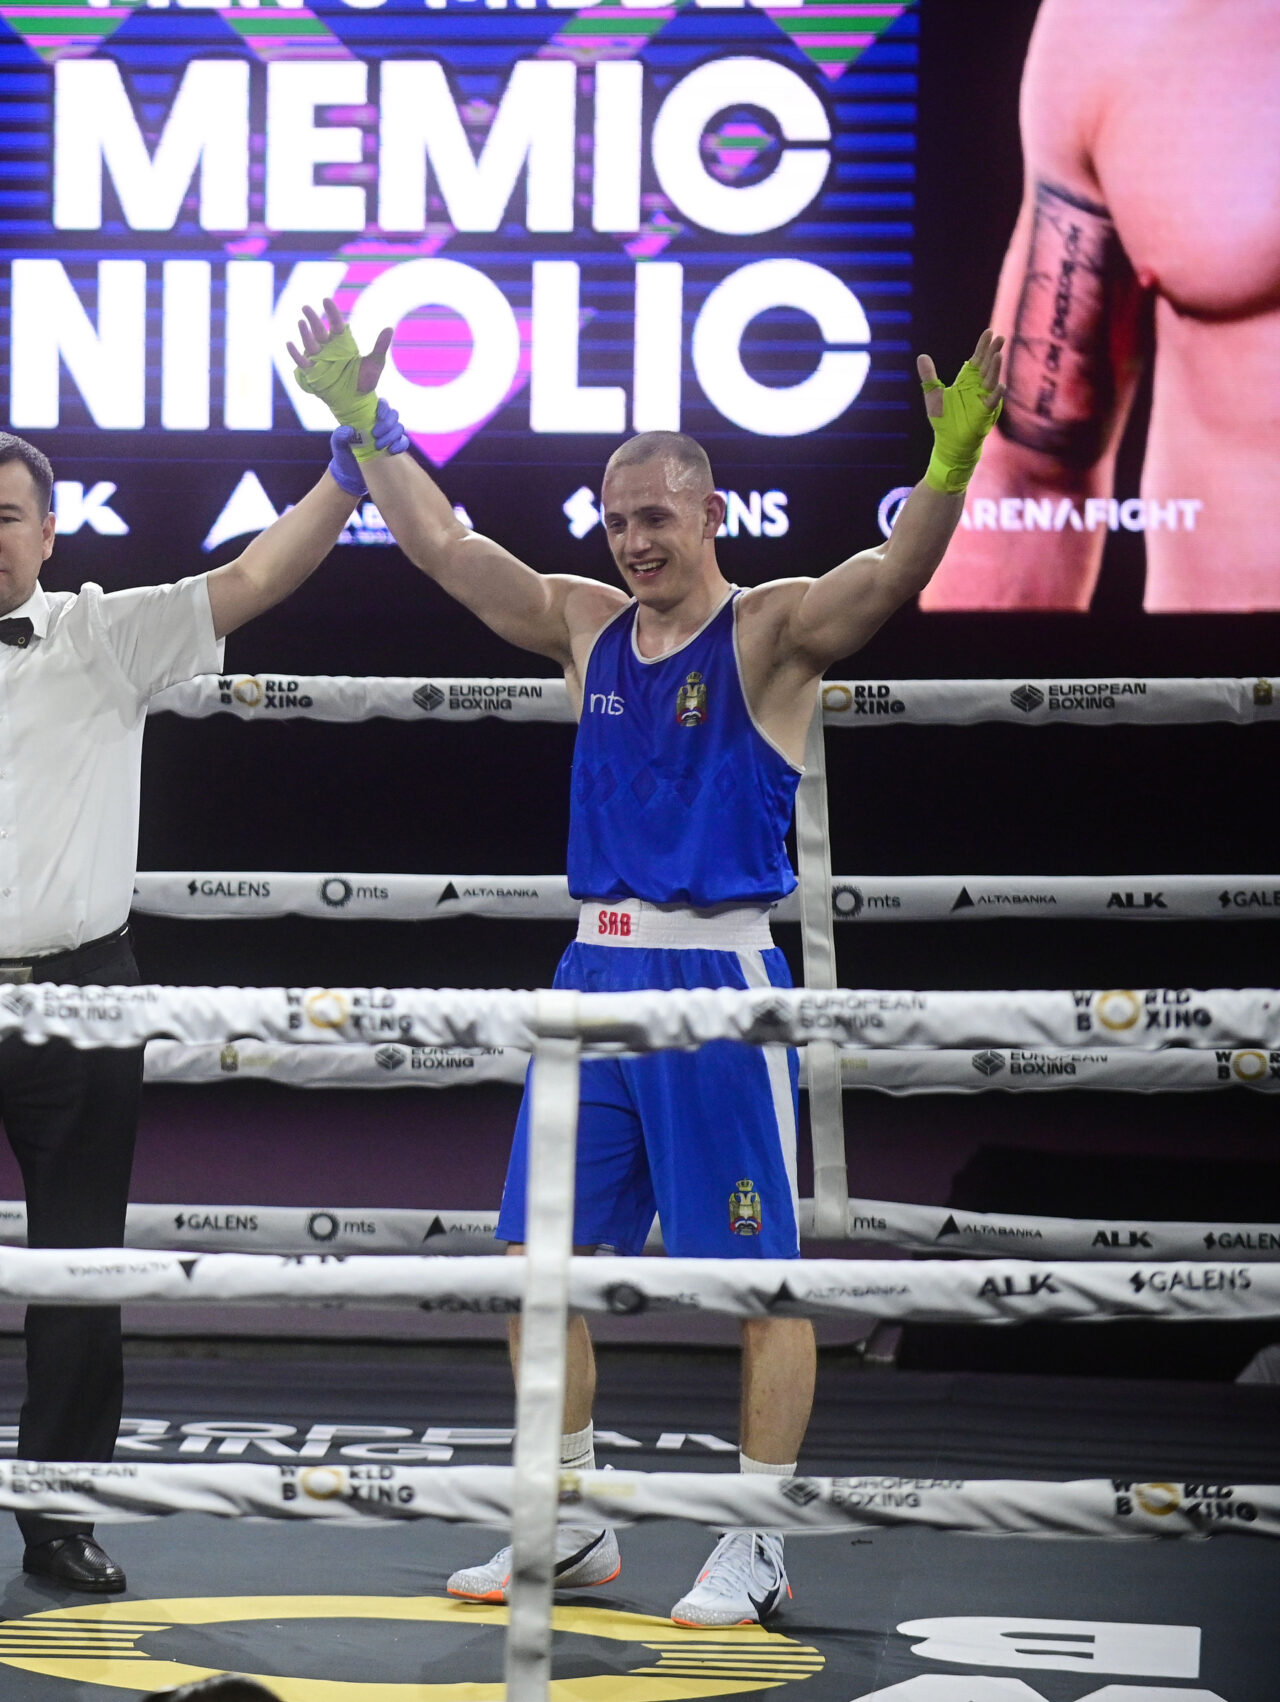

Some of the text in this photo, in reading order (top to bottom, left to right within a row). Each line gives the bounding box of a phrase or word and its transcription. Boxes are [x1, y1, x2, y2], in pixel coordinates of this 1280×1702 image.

[52, 55, 832, 235] MEMIC
[8, 257, 871, 436] NIKOLIC
[449, 684, 543, 700] EUROPEAN
[1048, 682, 1147, 697] EUROPEAN
[449, 698, 513, 711] BOXING
[1048, 697, 1116, 711] BOXING
[201, 880, 271, 898] GALENS
[356, 885, 389, 899] mts
[867, 894, 901, 908] mts
[1107, 891, 1168, 909] ALK
[1233, 891, 1280, 907] GALE
[597, 910, 632, 937] SRB
[411, 1056, 475, 1069] BOXING
[1010, 1062, 1077, 1075] BOXING
[188, 1214, 258, 1232] GALENS
[344, 1220, 376, 1234] mts
[854, 1215, 887, 1230] mts
[1092, 1230, 1154, 1248] ALK
[1219, 1231, 1280, 1249] GALEN
[977, 1273, 1061, 1298] ALK
[1149, 1269, 1252, 1293] GALENS
